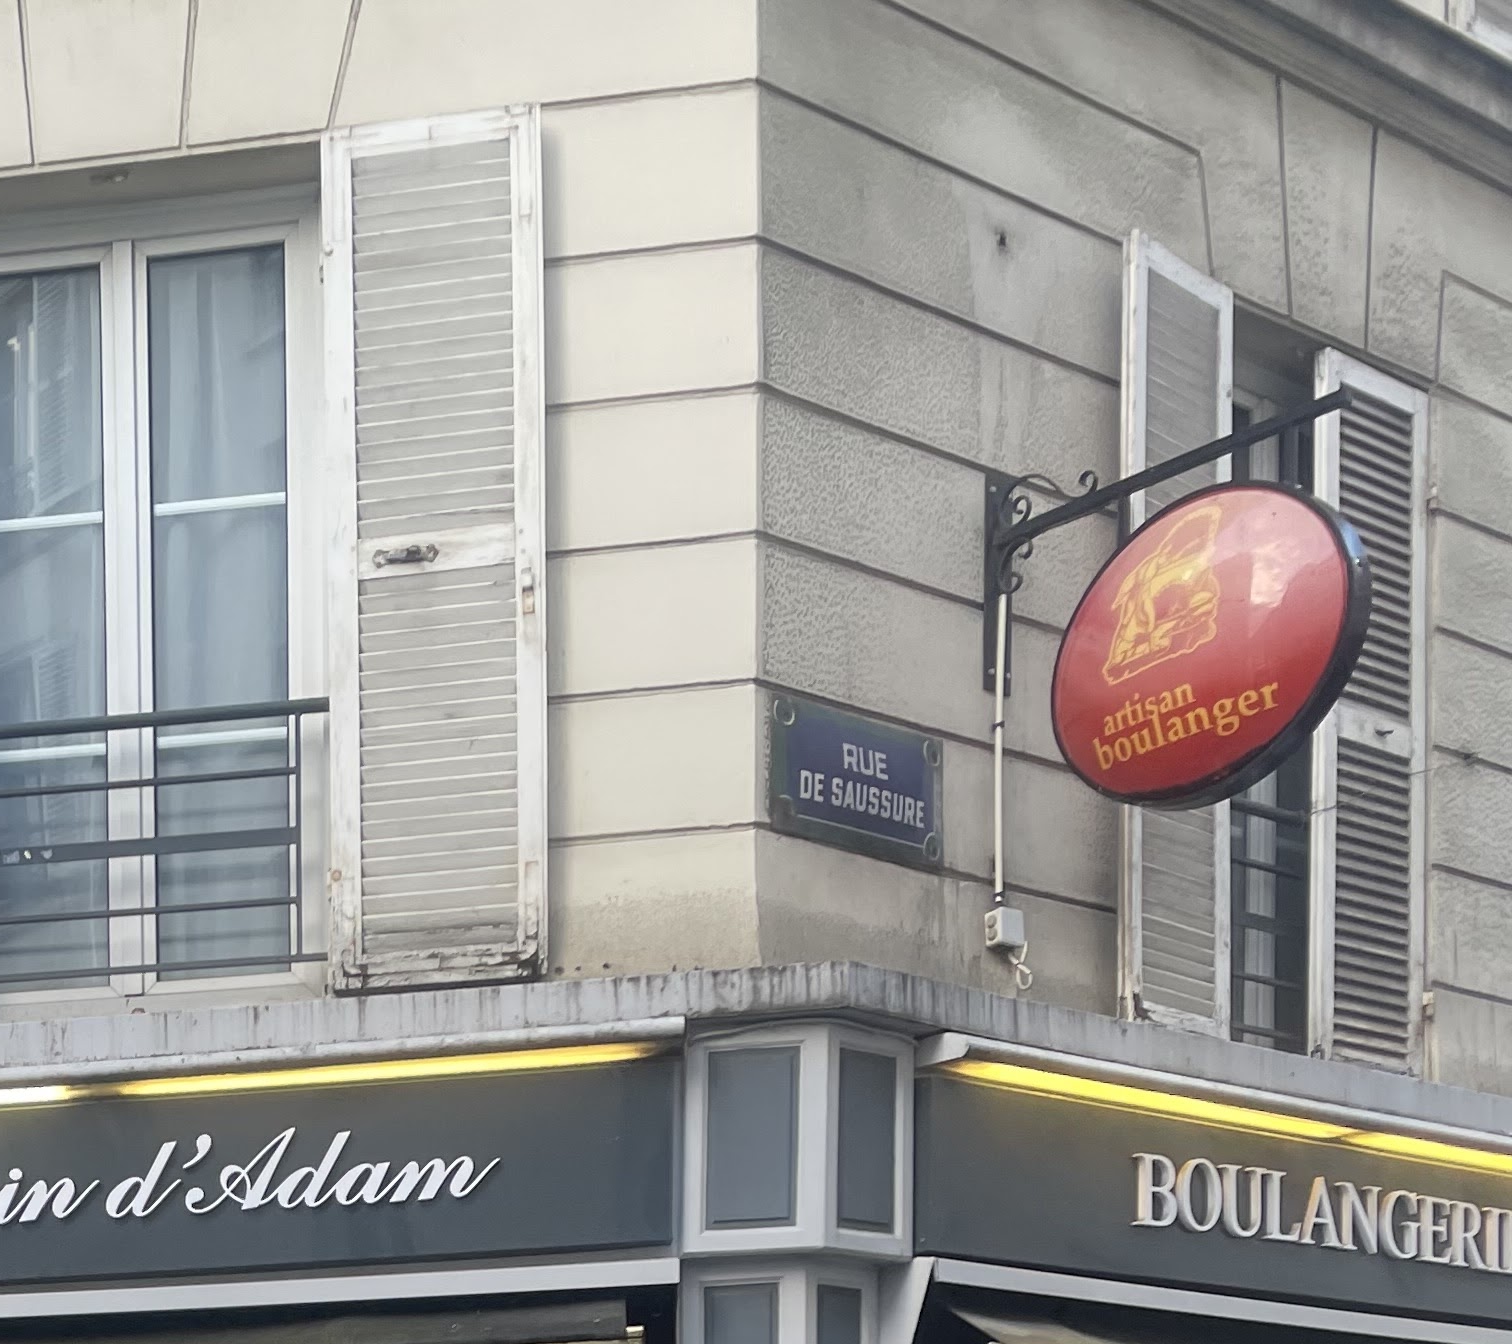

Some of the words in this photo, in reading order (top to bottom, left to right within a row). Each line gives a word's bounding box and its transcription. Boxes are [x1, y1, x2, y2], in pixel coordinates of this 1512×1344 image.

[1092, 681, 1280, 771] boulanger
[1103, 682, 1197, 737] artisan
[799, 769, 825, 803] DE
[831, 776, 926, 829] SAUSSURE
[842, 742, 889, 781] RUE
[104, 1126, 502, 1220] d'Adam
[1130, 1151, 1512, 1274] BOULANGERI
